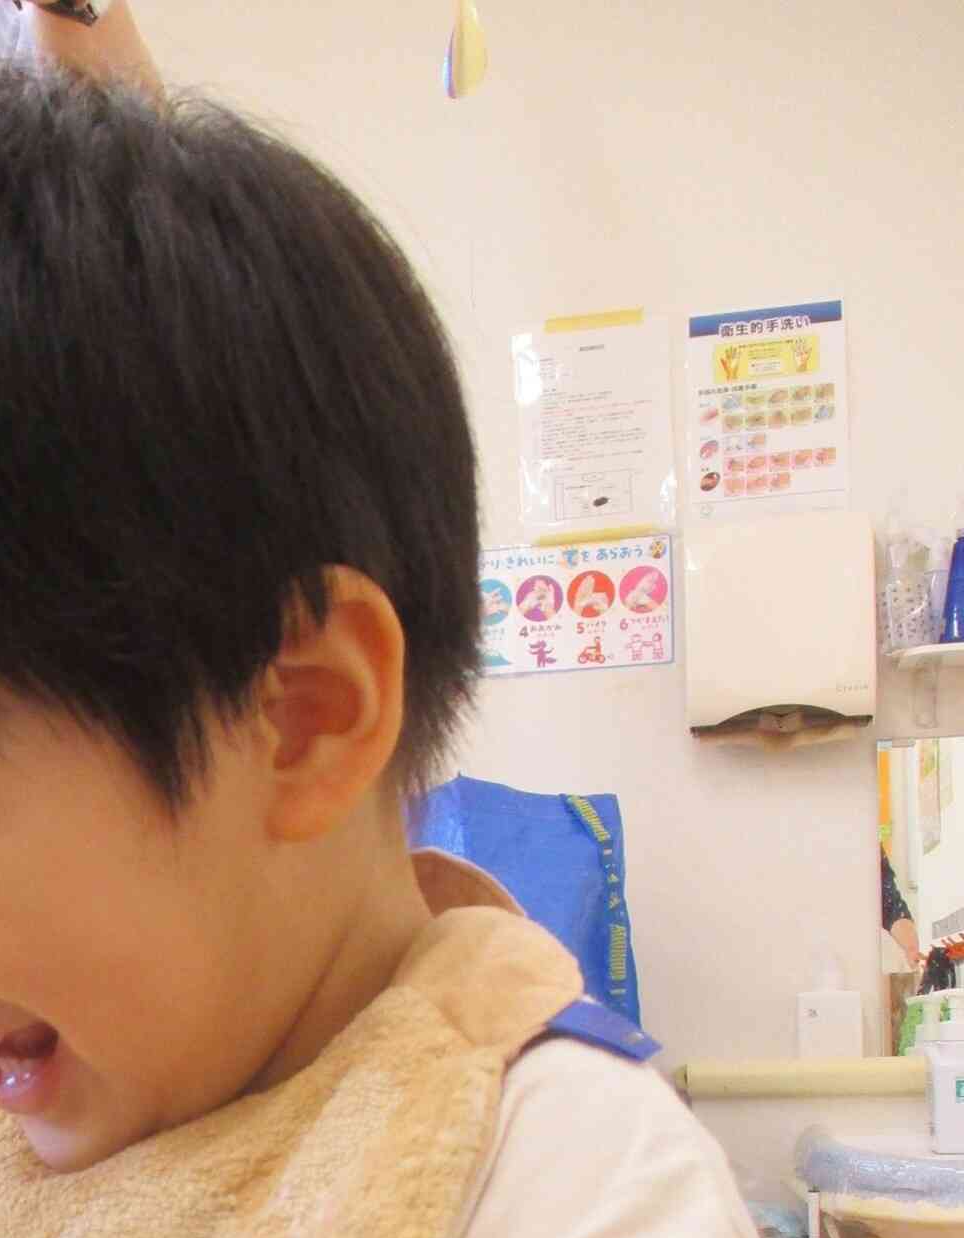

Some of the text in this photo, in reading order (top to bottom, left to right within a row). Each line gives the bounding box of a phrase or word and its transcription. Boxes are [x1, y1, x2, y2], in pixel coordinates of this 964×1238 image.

[720, 317, 811, 338] 衛生的手洗い
[576, 622, 585, 634] 5
[619, 618, 629, 630] 6
[519, 626, 529, 638] 4
